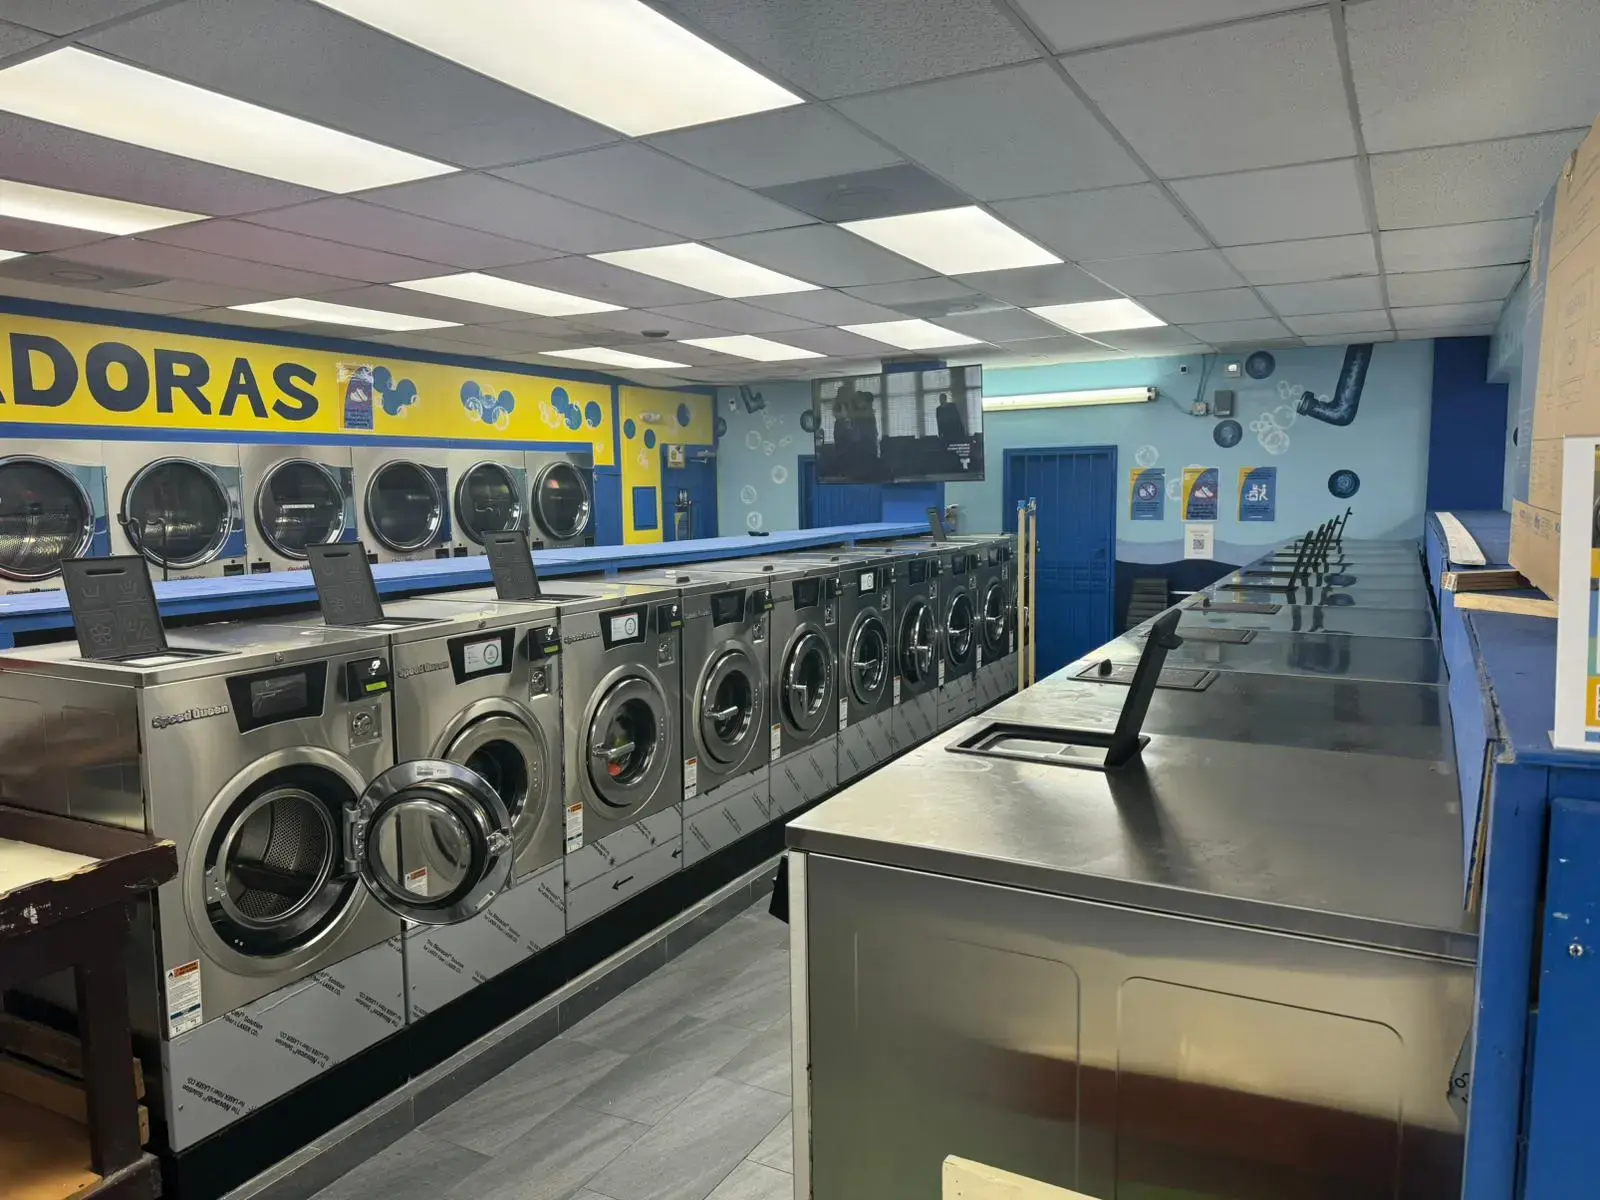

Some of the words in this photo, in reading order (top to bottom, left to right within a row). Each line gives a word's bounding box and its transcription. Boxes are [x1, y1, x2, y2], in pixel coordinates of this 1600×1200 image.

[0, 332, 319, 421] DORAS
[151, 709, 192, 729] Speed
[191, 702, 229, 719] Queen
